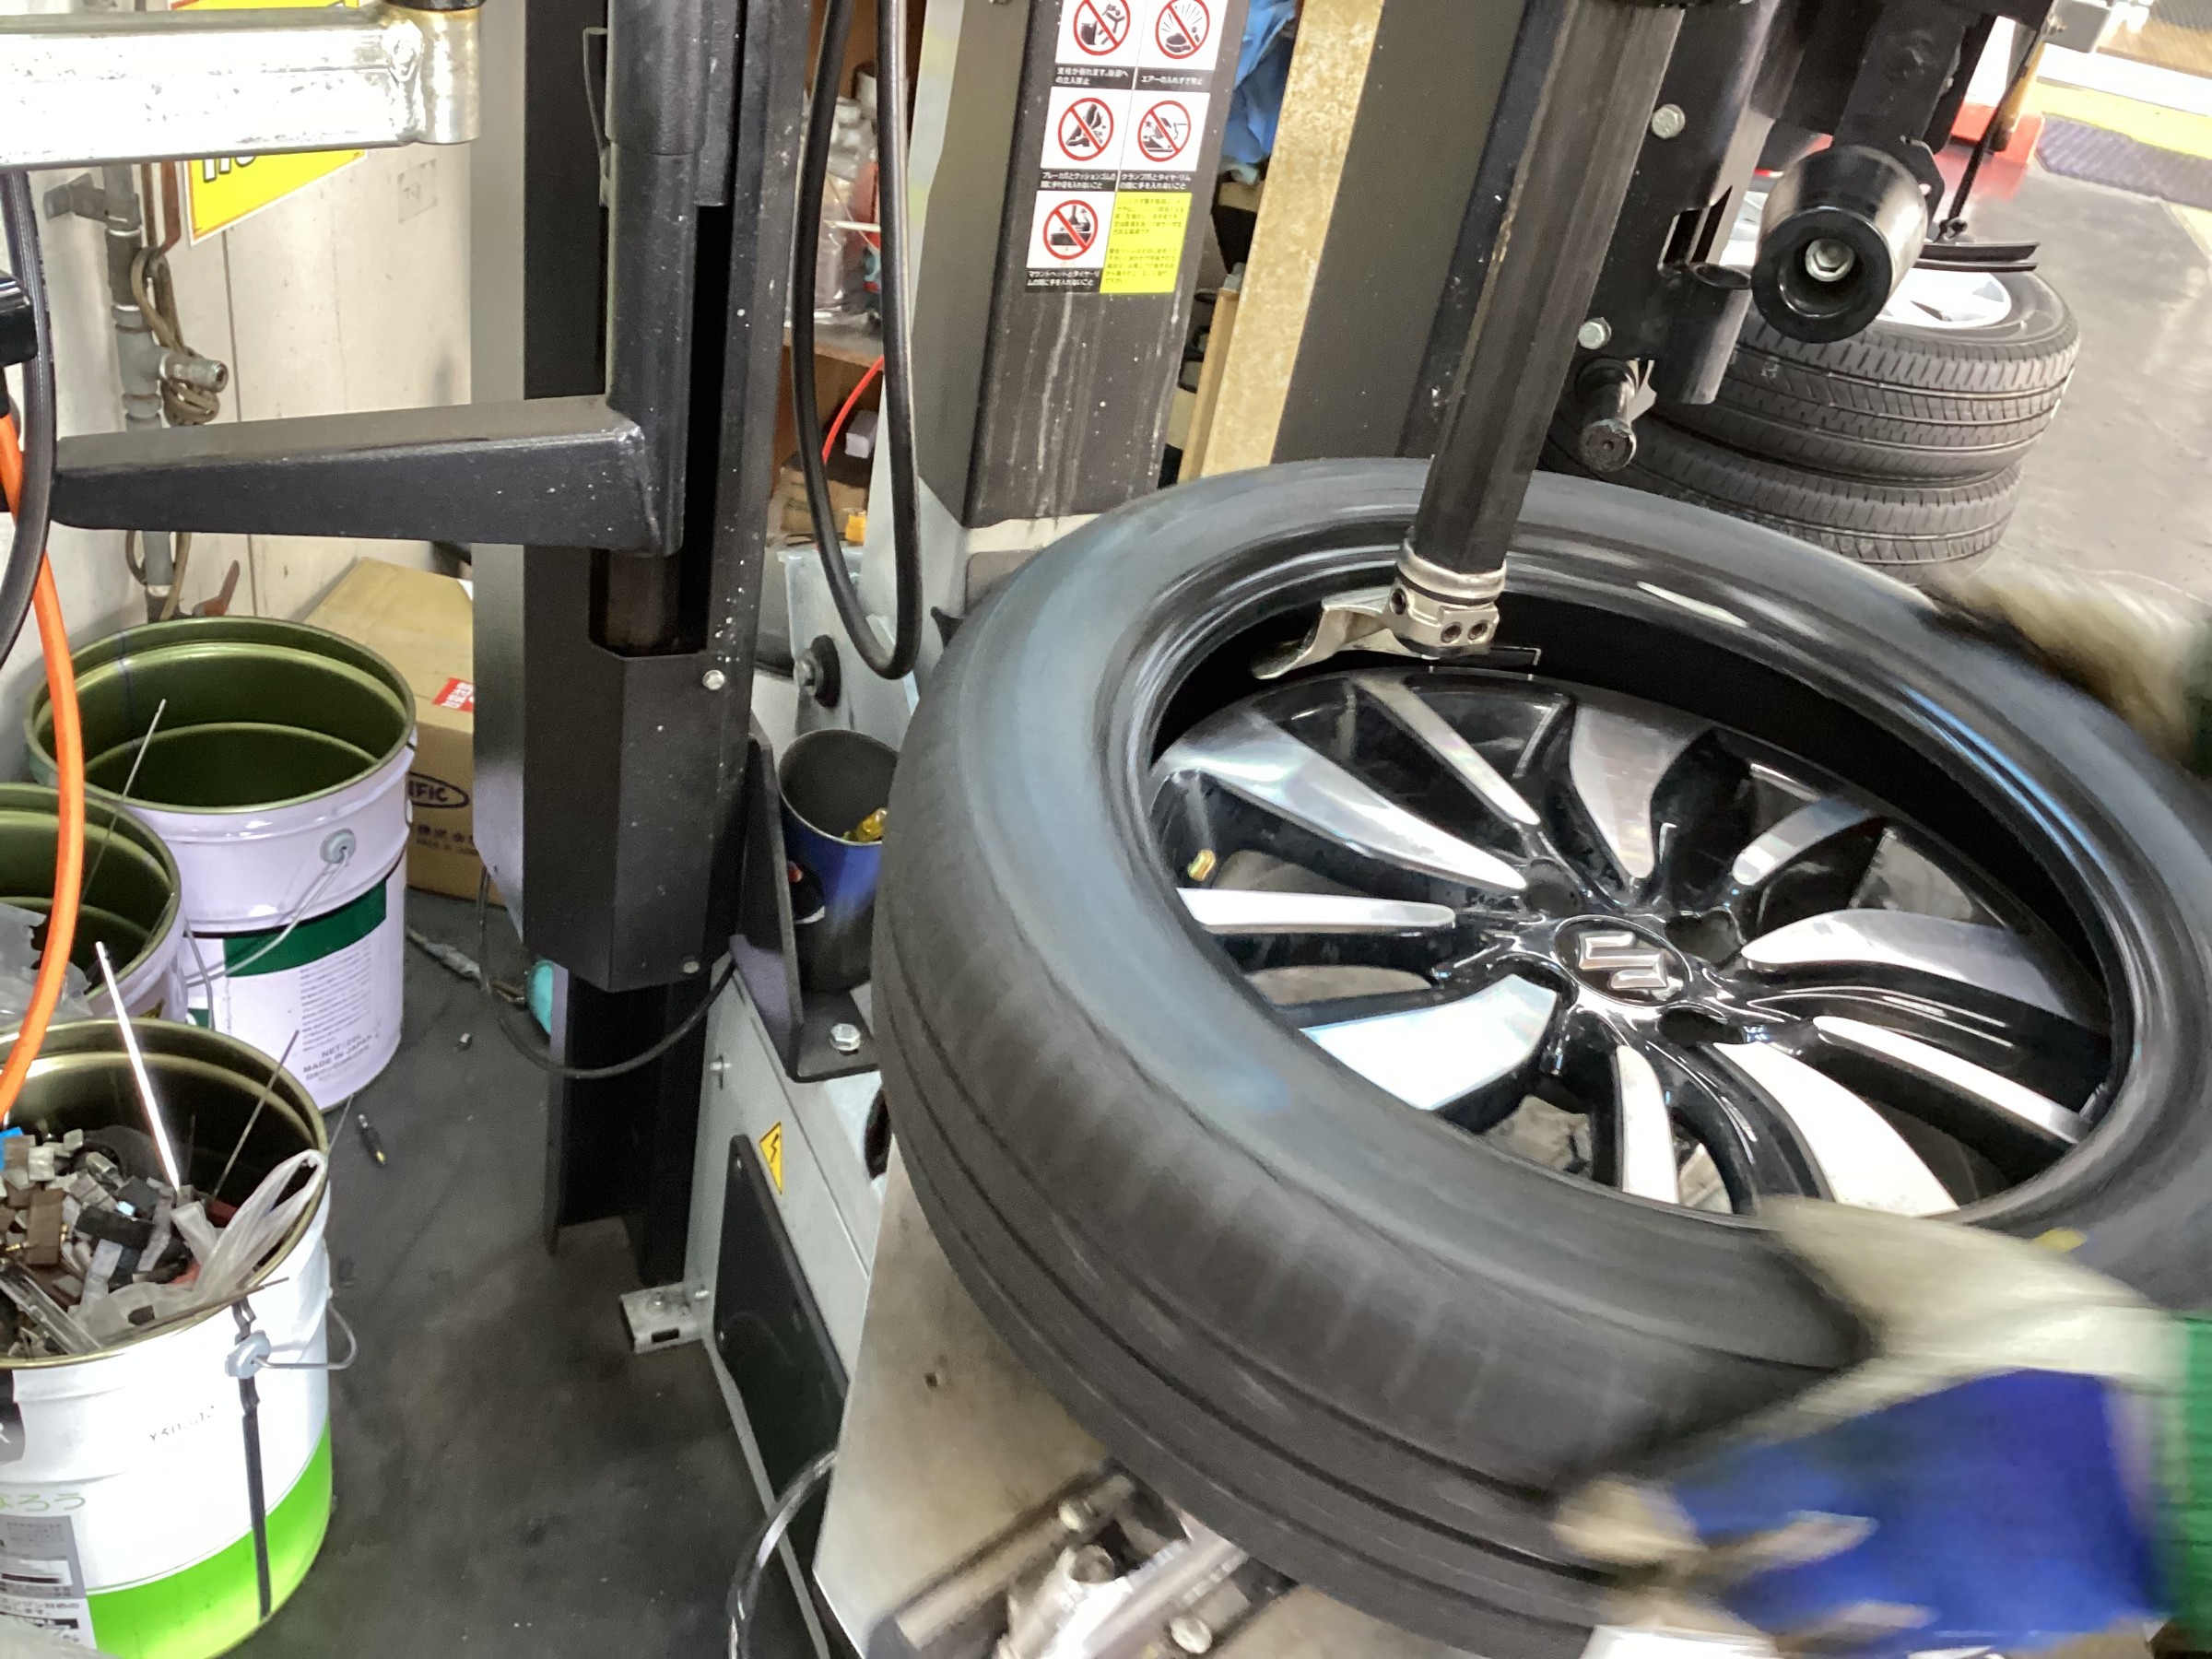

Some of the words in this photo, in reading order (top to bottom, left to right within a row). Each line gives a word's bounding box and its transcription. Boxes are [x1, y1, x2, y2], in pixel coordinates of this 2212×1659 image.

[303, 1057, 332, 1074] MADE
[334, 1051, 344, 1061] IN
[346, 1034, 371, 1055] JAPAN
